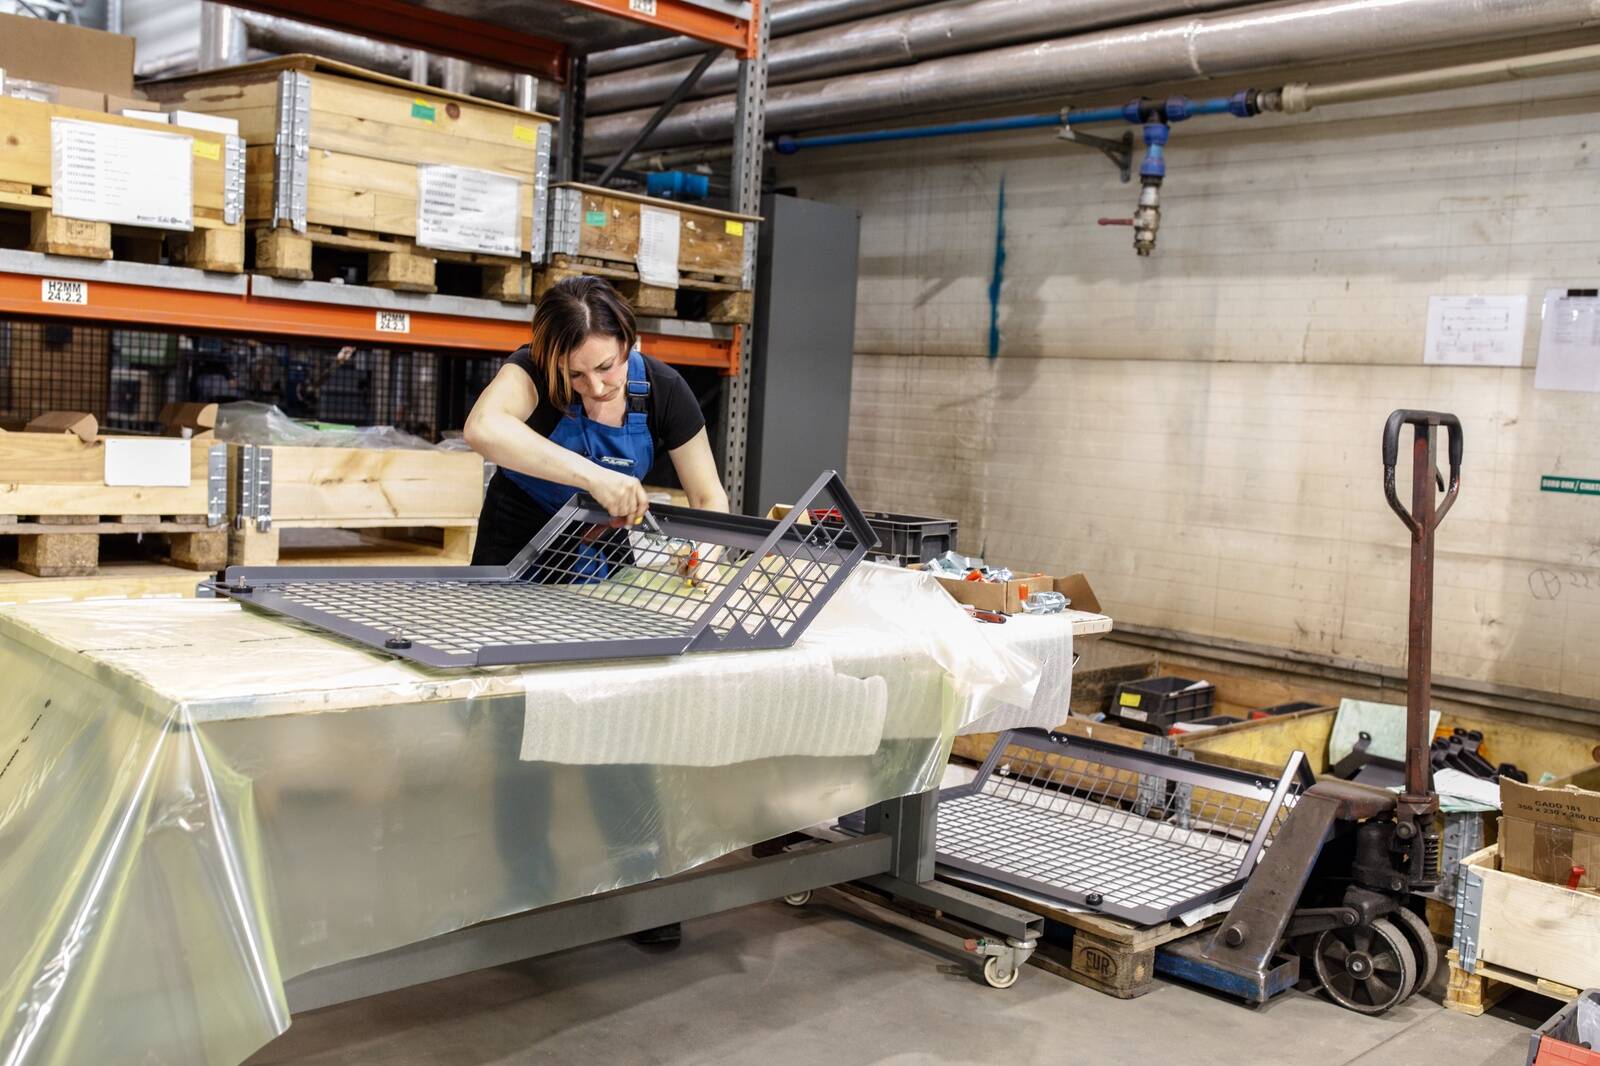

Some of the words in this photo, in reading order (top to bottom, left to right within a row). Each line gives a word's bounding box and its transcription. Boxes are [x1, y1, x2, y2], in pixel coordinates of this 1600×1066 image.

[48, 281, 81, 292] H2MM
[48, 290, 82, 303] 24.2.2
[1087, 951, 1109, 975] EUR
